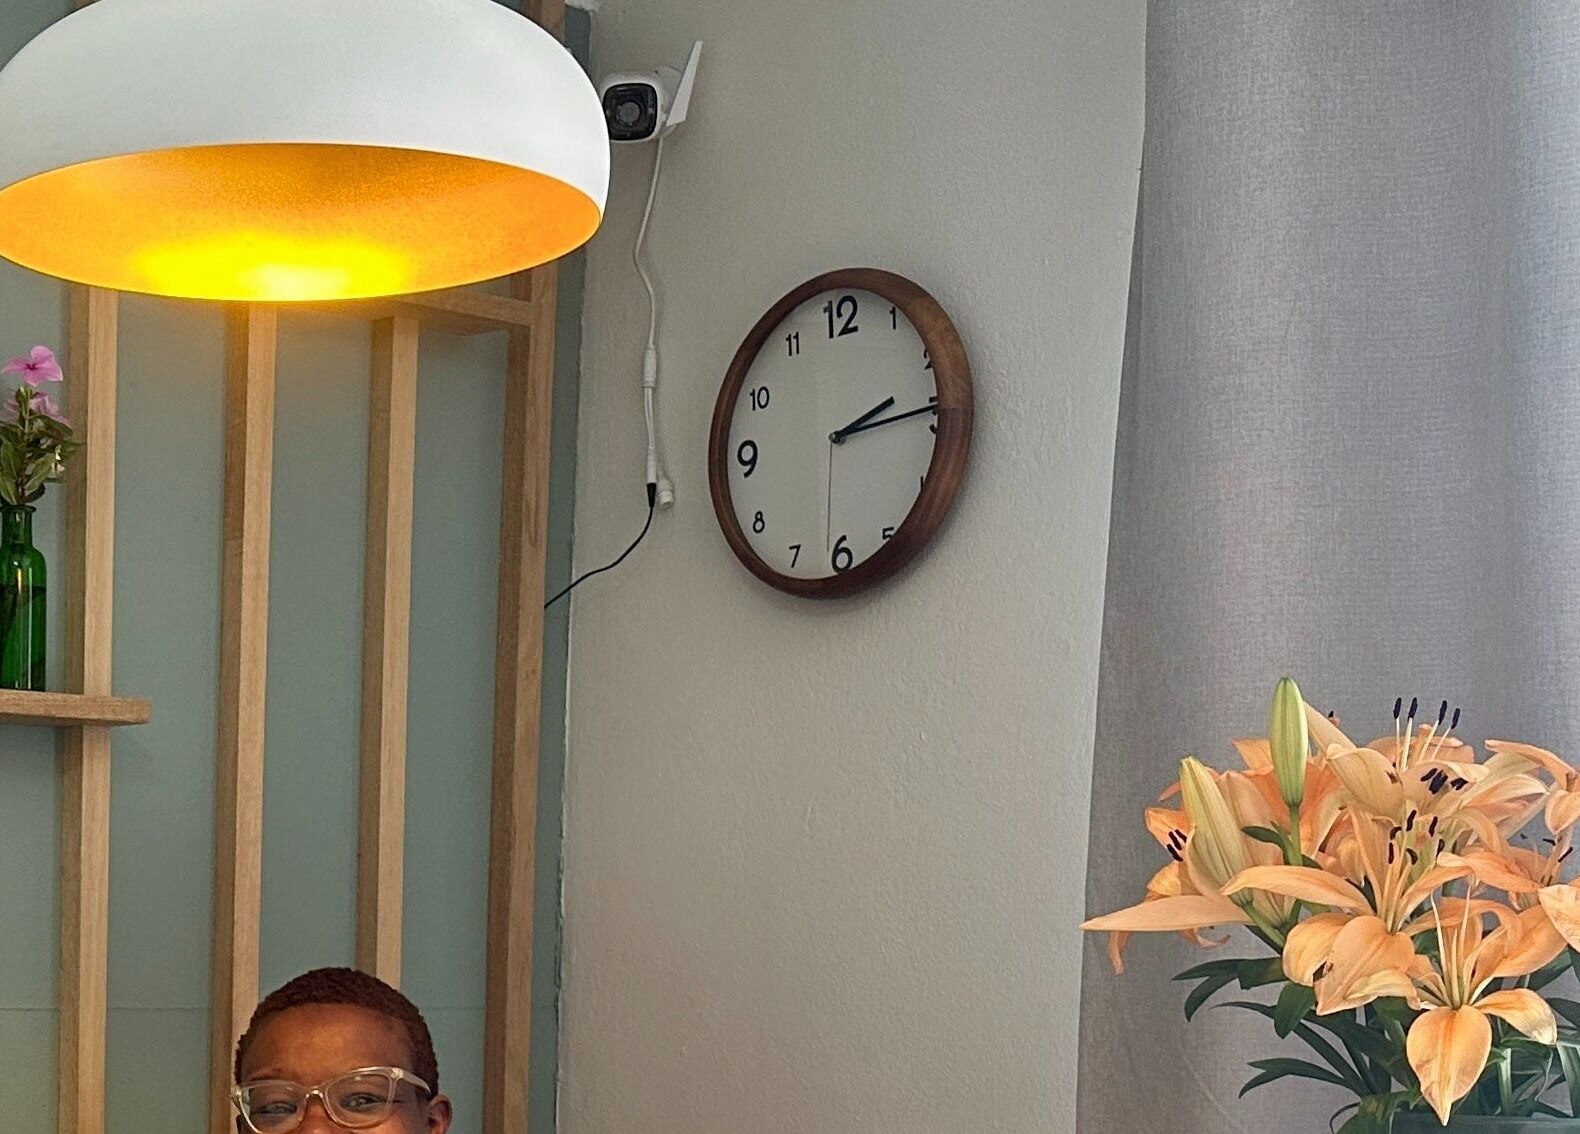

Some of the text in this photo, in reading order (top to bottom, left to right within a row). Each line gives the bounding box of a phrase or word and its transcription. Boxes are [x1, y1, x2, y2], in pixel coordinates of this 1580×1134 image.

[823, 295, 859, 338] 12
[889, 306, 897, 330] 1
[785, 332, 800, 356] 11
[749, 386, 770, 411] 10
[737, 440, 758, 478] 9
[752, 511, 765, 533] 8
[789, 544, 801, 568] 7
[831, 535, 853, 573] 6
